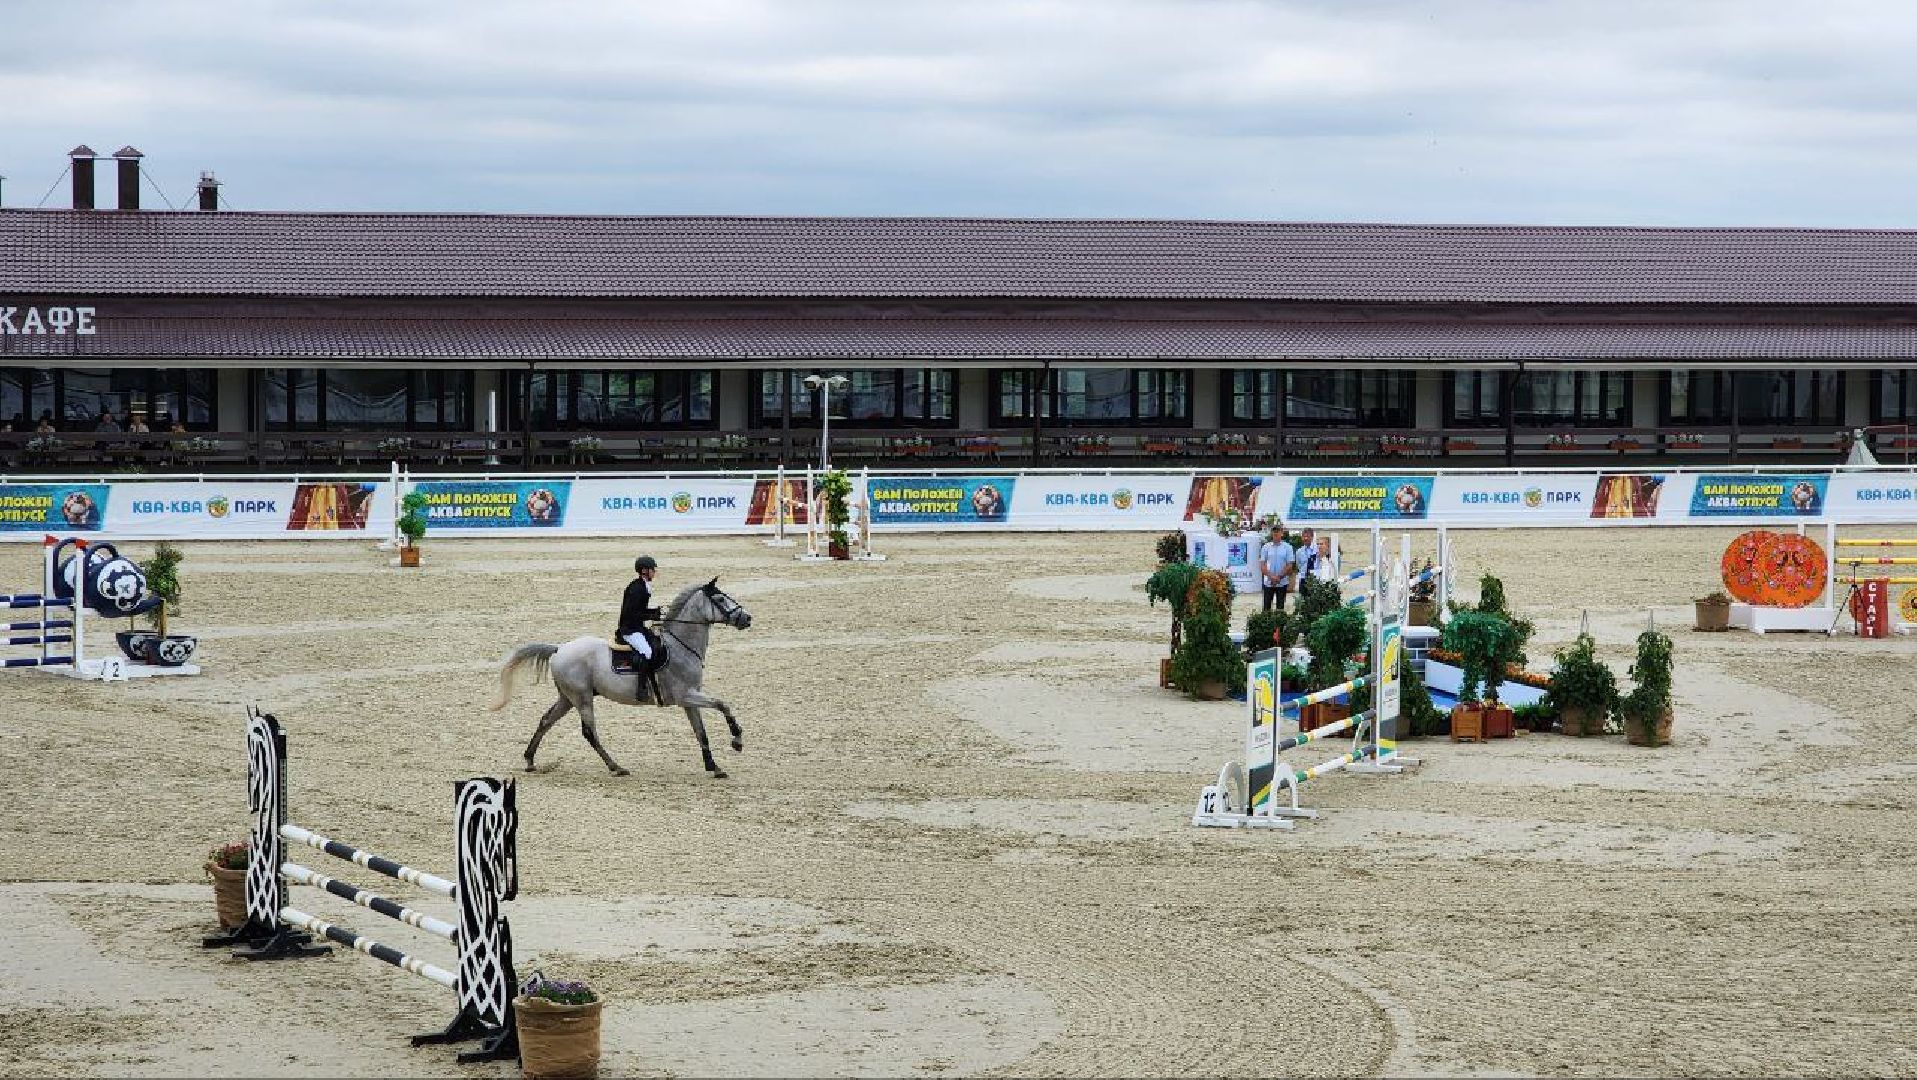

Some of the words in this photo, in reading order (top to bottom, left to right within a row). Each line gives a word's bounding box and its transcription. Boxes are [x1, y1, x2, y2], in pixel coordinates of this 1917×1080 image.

[0, 306, 96, 335] КАФЕ
[873, 488, 901, 500] ВАМ
[903, 488, 963, 499] ПОЛОЖЕН
[1303, 487, 1329, 498] ВАМ
[1331, 487, 1387, 498] ПОЛОЖЕН
[1703, 485, 1729, 495] ВАМ
[1731, 485, 1784, 495] ПОЛОЖЕН
[454, 493, 517, 504] ПОЛОЖЕН
[696, 496, 736, 509] ПАРК
[1137, 493, 1175, 505] ПАРК
[1546, 491, 1581, 503] ПАРК
[1707, 497, 1779, 507] АКВАОТПУСК
[234, 500, 277, 513] ПАРК
[879, 502, 959, 513] АКВАОТПУСК
[1307, 500, 1381, 510] АКВАОТПУСК
[428, 506, 511, 517] АКВАОТПУСК
[1866, 583, 1877, 636] СТАРТ
[112, 661, 120, 678] 2
[1203, 792, 1217, 814] 12
